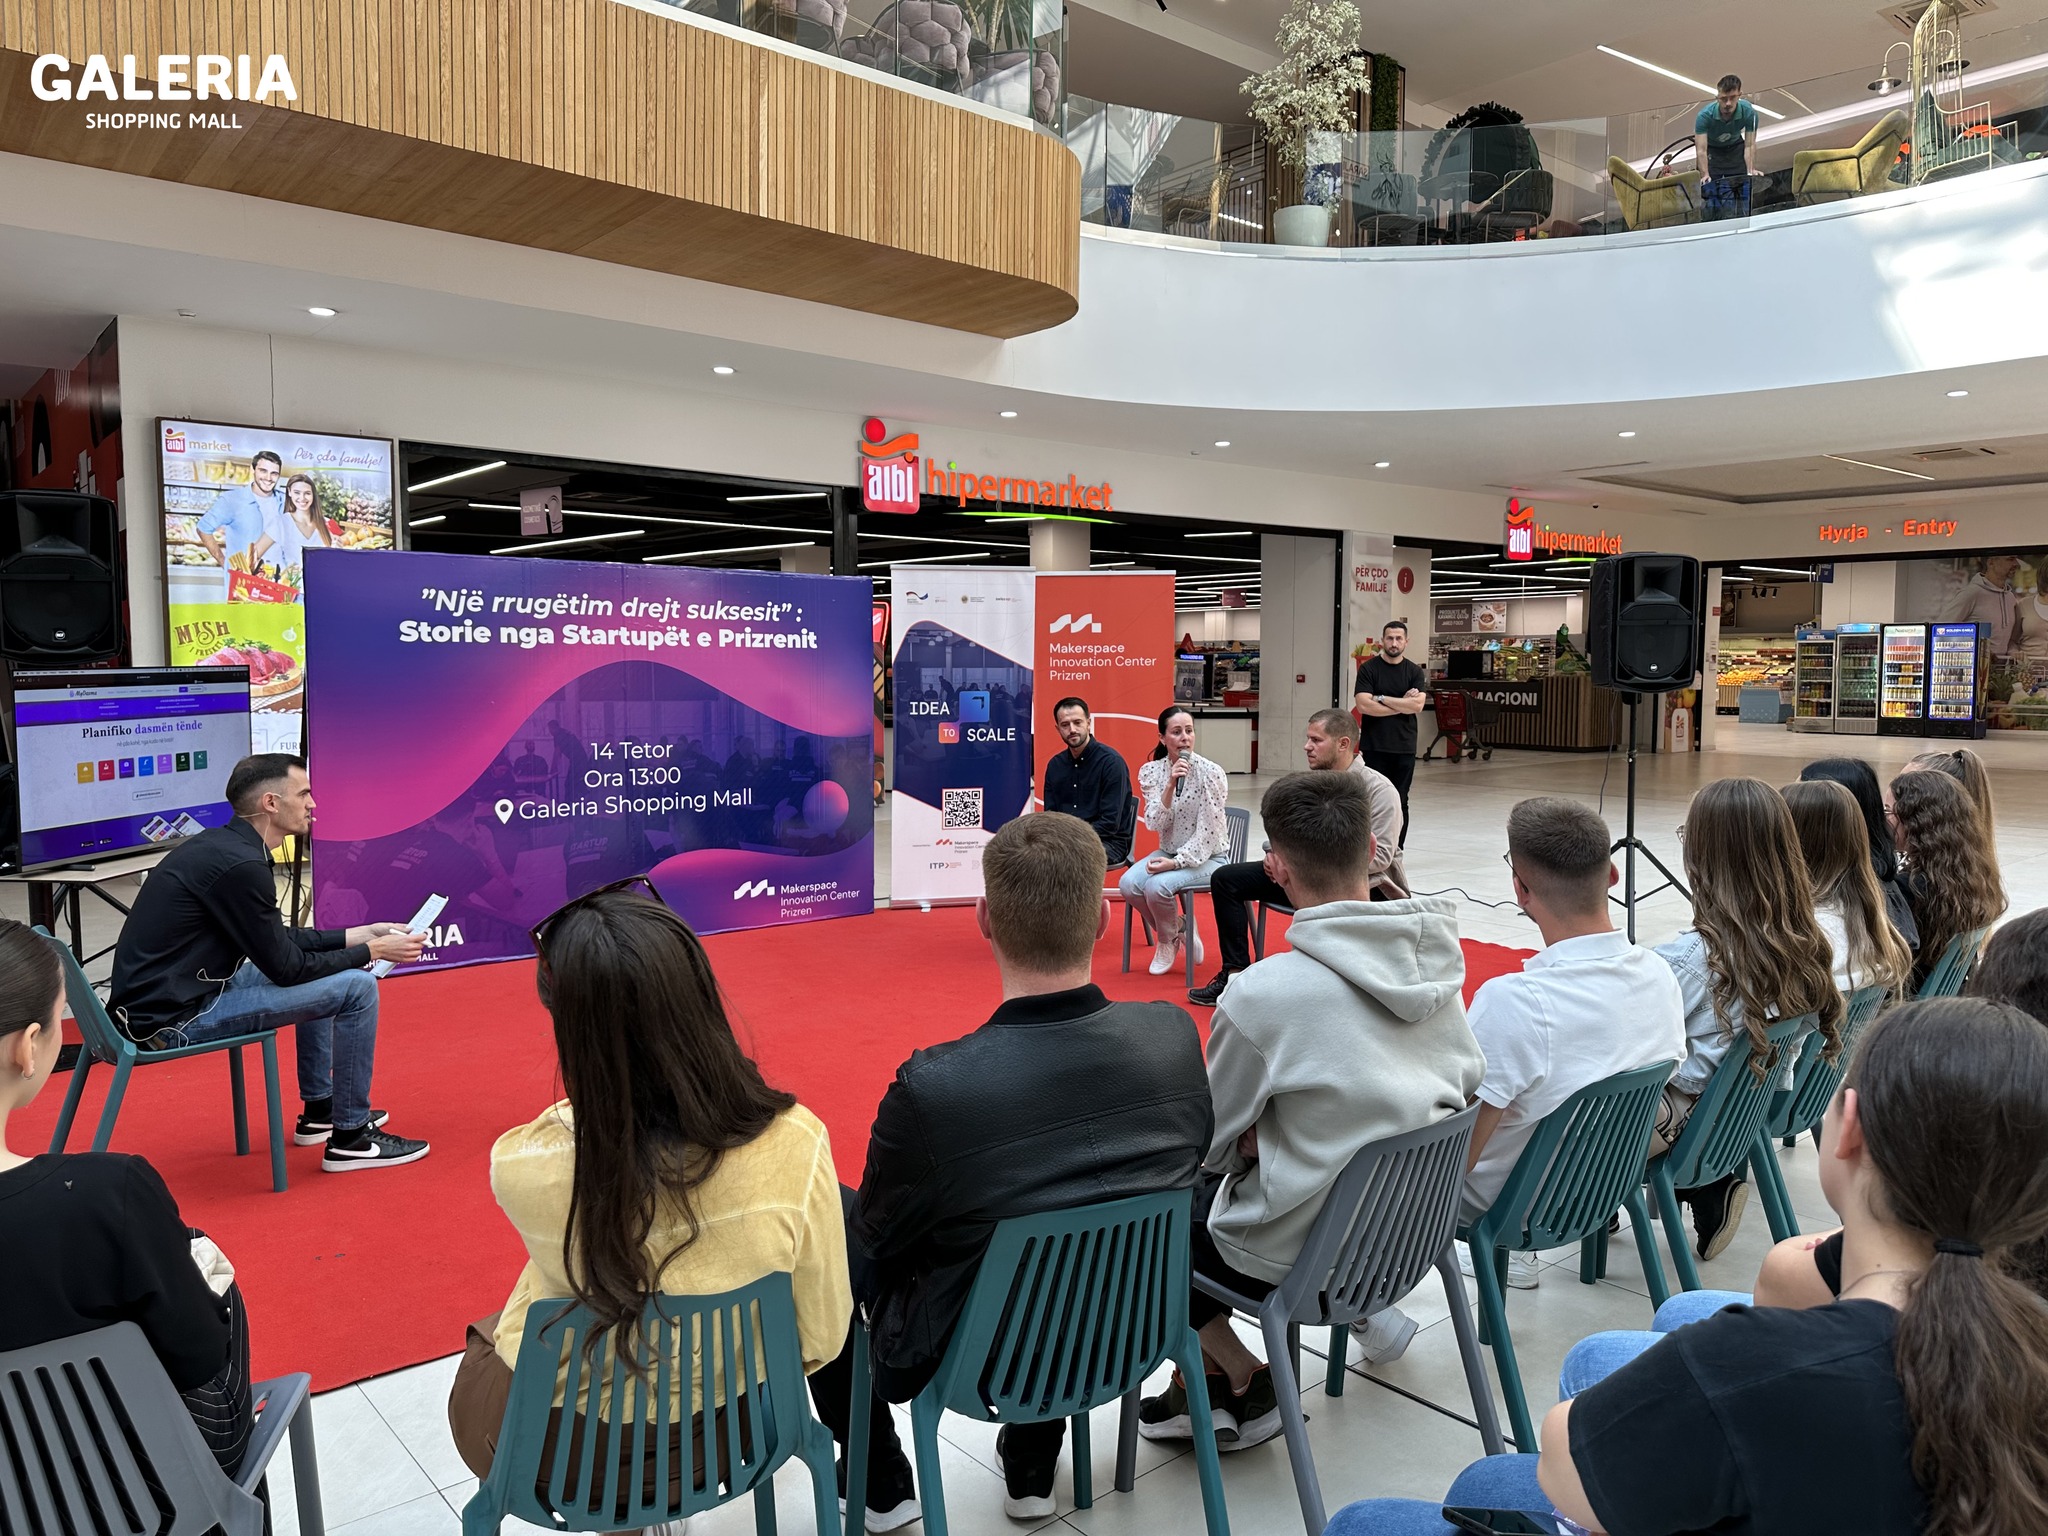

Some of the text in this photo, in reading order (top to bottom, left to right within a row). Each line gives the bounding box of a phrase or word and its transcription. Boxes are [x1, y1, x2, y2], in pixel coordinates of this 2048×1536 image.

[189, 440, 232, 452] market
[294, 447, 384, 468] Për çdo familje!
[926, 458, 1114, 512] hipermarket
[1535, 522, 1623, 556] hipermarket
[1819, 523, 1869, 543] Hyrja
[1903, 519, 1958, 537] Entry
[1356, 565, 1389, 581] PËR ÇDO
[1355, 582, 1388, 592] FAMILJE
[491, 593, 614, 619] rrugëtim
[621, 597, 681, 623] drejt
[175, 621, 230, 646] MISH
[399, 619, 818, 651] Storie nga Startupët e Prizrenit
[1049, 642, 1126, 657] Makerspace
[1049, 655, 1157, 668] Innovation Center
[1049, 669, 1092, 681] Prizren
[1474, 691, 1538, 706] MACIONI
[909, 701, 951, 715] IDEA
[82, 720, 203, 738] Planifiko dasmën tënde
[942, 727, 1016, 742] TO SCALE
[280, 741, 301, 751] FUR
[590, 741, 674, 761] 14 Tetor
[583, 766, 682, 788] Ora 13:00
[518, 787, 752, 820] Galeria Shopping Mall
[780, 881, 838, 895] Makerspace
[780, 889, 860, 907] Innovation Center
[780, 907, 812, 918] Prizren
